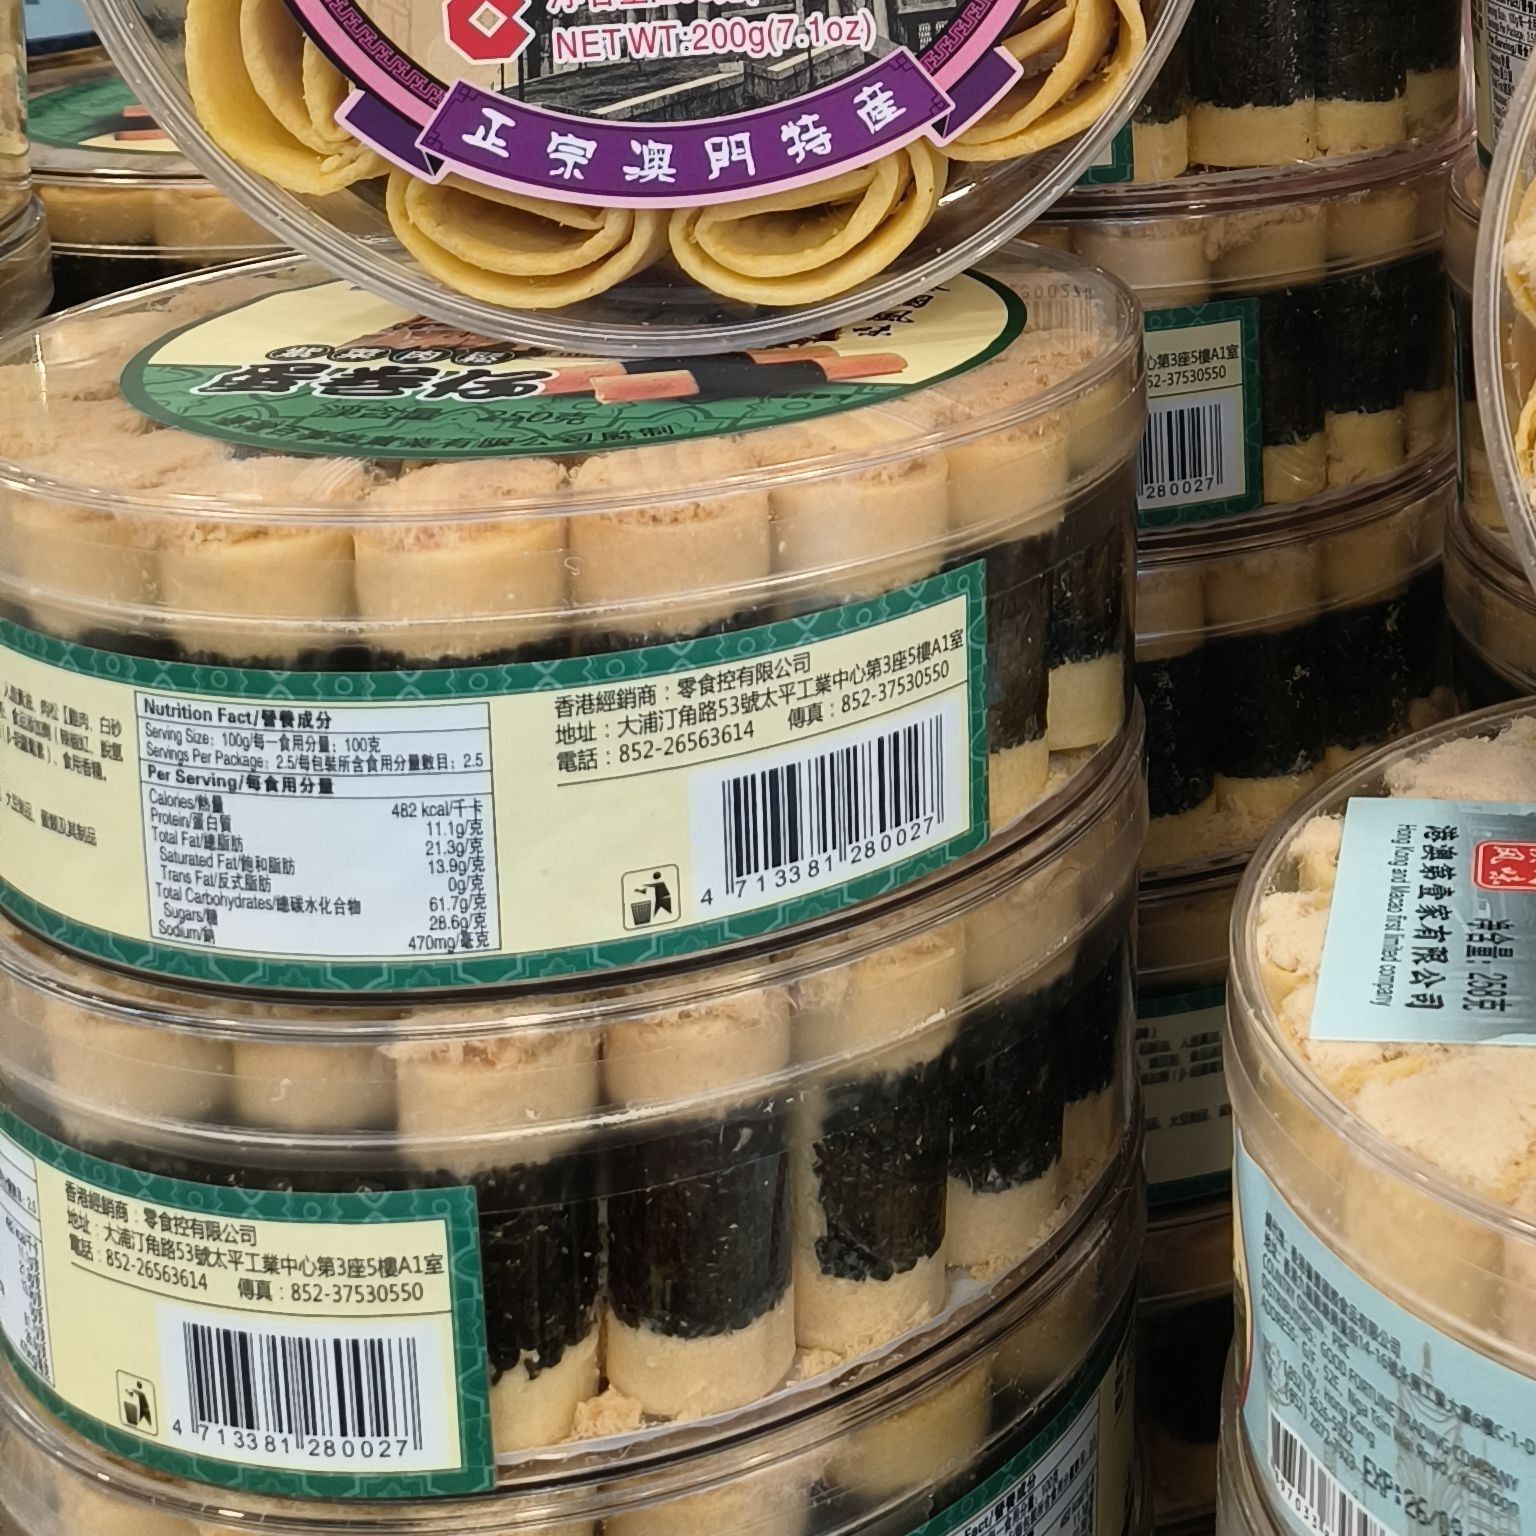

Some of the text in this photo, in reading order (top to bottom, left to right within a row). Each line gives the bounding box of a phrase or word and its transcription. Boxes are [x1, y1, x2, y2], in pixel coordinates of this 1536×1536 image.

[552, 24, 624, 63] NET
[461, 85, 907, 186] 正宗澳門特產
[144, 698, 214, 722] Nutrition
[145, 722, 184, 746] Serving
[146, 741, 190, 764] Servings
[192, 747, 213, 764] Per
[463, 753, 484, 768] 2.5
[147, 764, 174, 782] Per
[391, 801, 417, 818] 482
[151, 825, 179, 845] Total
[159, 846, 215, 869] Saturated
[161, 865, 193, 885] Trans
[156, 882, 183, 903] Total
[701, 888, 714, 906] 4
[172, 1418, 183, 1435] 4
[308, 1439, 409, 1458] 280027
